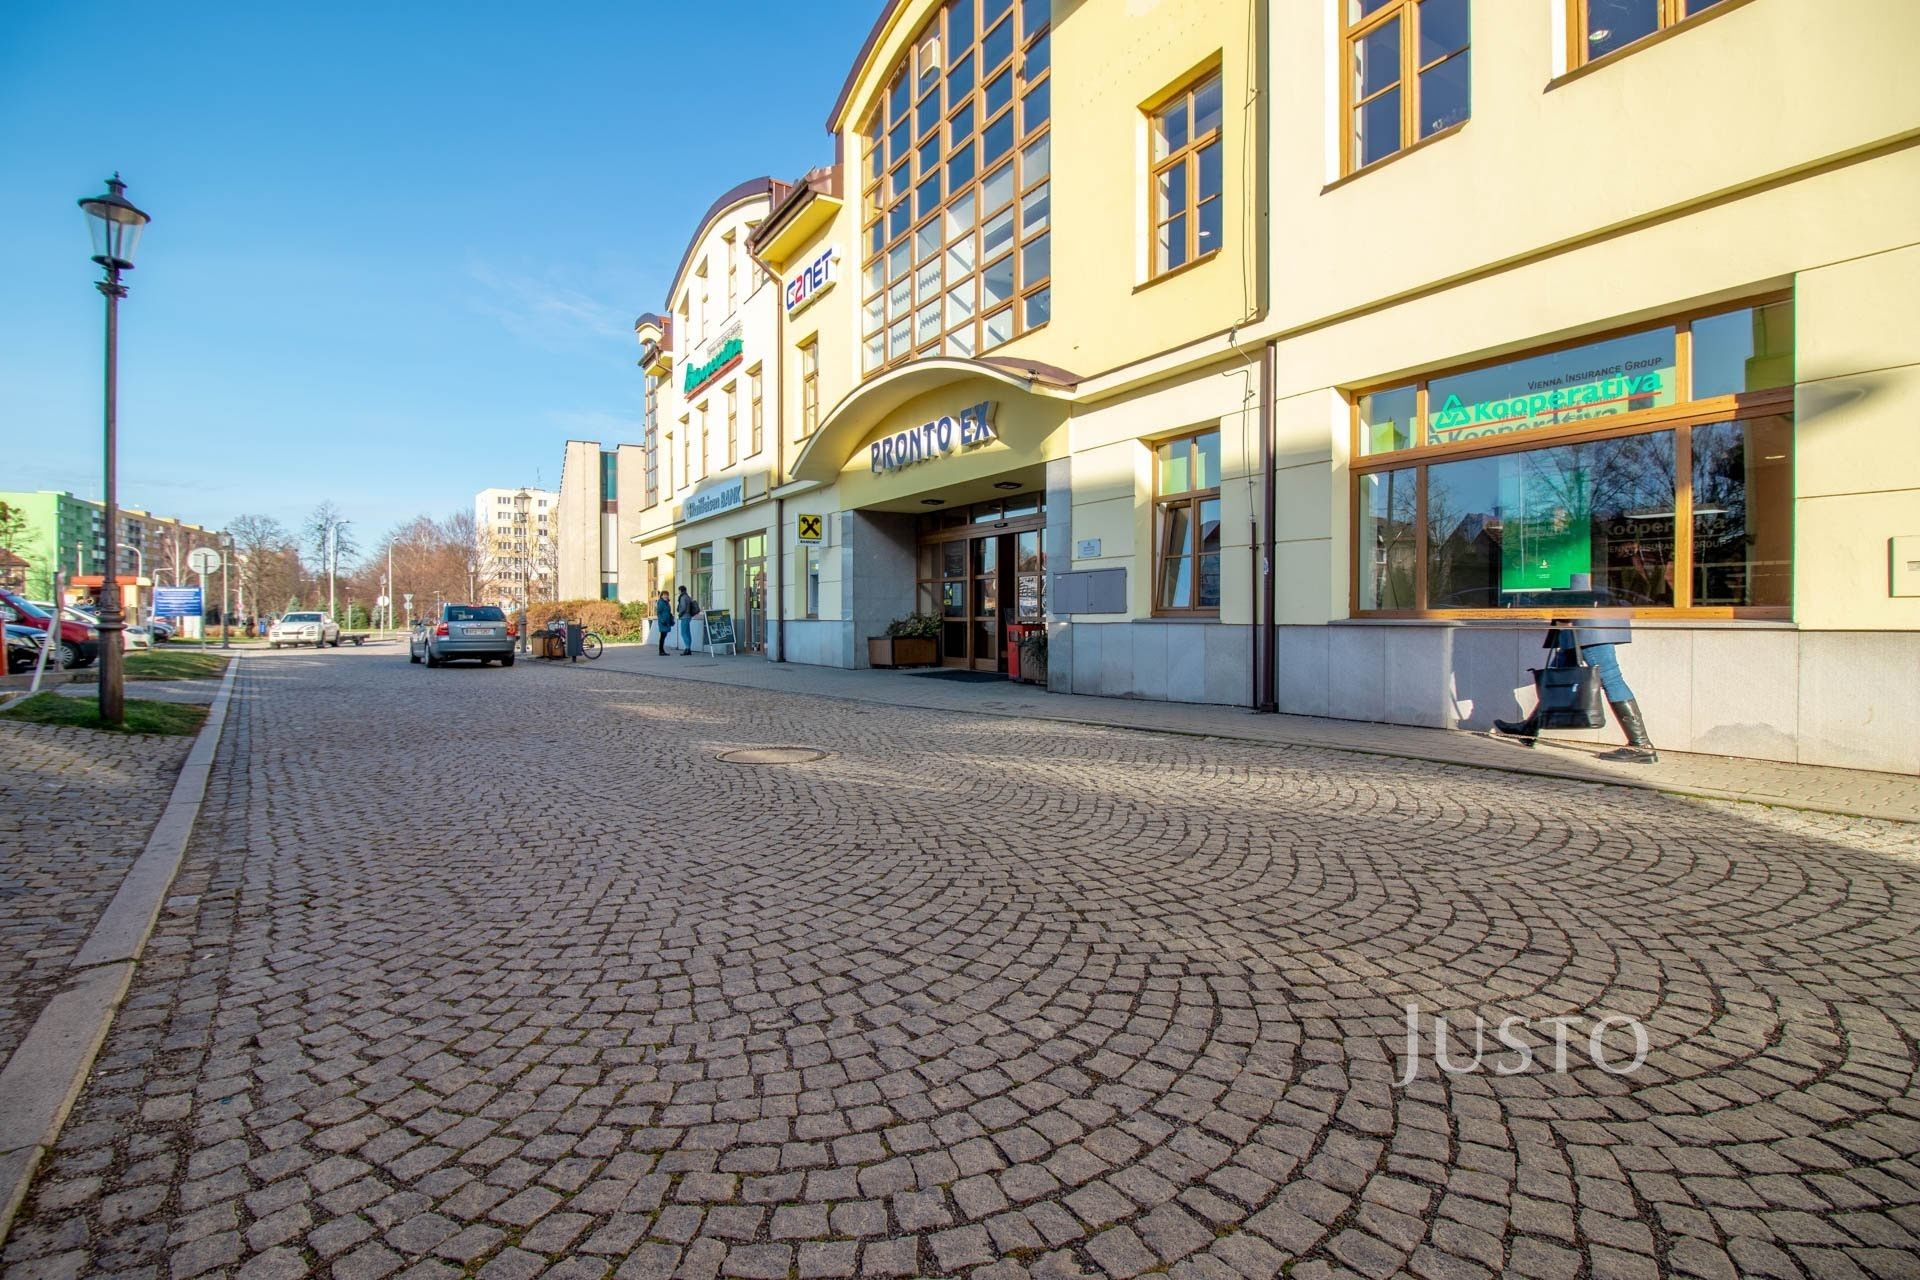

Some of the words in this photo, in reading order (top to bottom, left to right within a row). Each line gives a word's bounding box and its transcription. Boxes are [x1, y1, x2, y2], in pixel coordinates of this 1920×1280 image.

[1528, 378, 1561, 390] VIENNA
[1566, 365, 1621, 382] INSURANCE
[1625, 357, 1662, 371] GROUP
[1474, 371, 1663, 421] Kooperativa
[871, 416, 952, 473] PRONTO
[960, 400, 990, 446] EX
[720, 485, 741, 508] BANK
